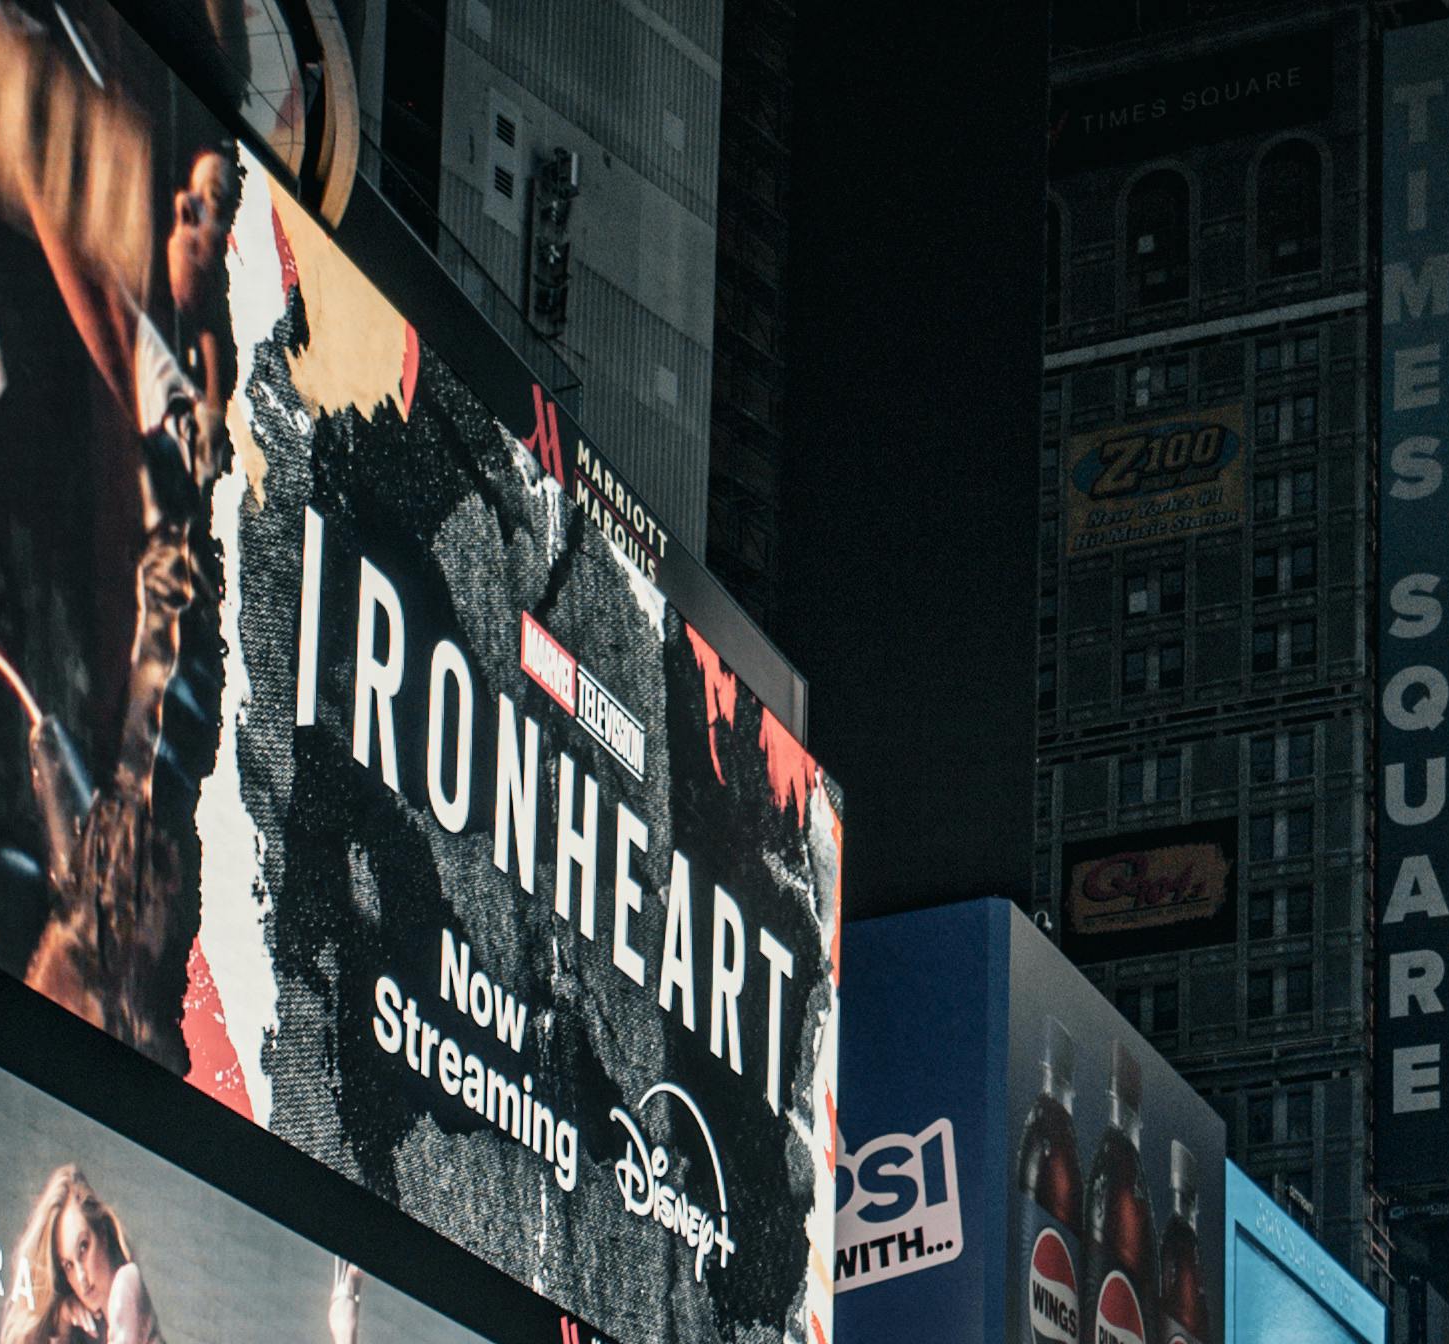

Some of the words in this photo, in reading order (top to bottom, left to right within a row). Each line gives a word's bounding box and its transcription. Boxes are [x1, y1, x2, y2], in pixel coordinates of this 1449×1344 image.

[1080, 98, 1167, 135] TIMES
[1181, 65, 1302, 113] SQUARE
[576, 439, 668, 558] MARRIOTT
[1090, 426, 1224, 500] Z100
[576, 479, 658, 584] MARQUIS
[524, 618, 576, 711] MARVEL
[577, 671, 645, 776] TELEVISION
[295, 506, 794, 1116] IRONHEART
[440, 928, 527, 1054] Now
[373, 975, 579, 1192] Streaming
[609, 1082, 735, 1284] Disney+
[1031, 1279, 1078, 1339] WINGS
